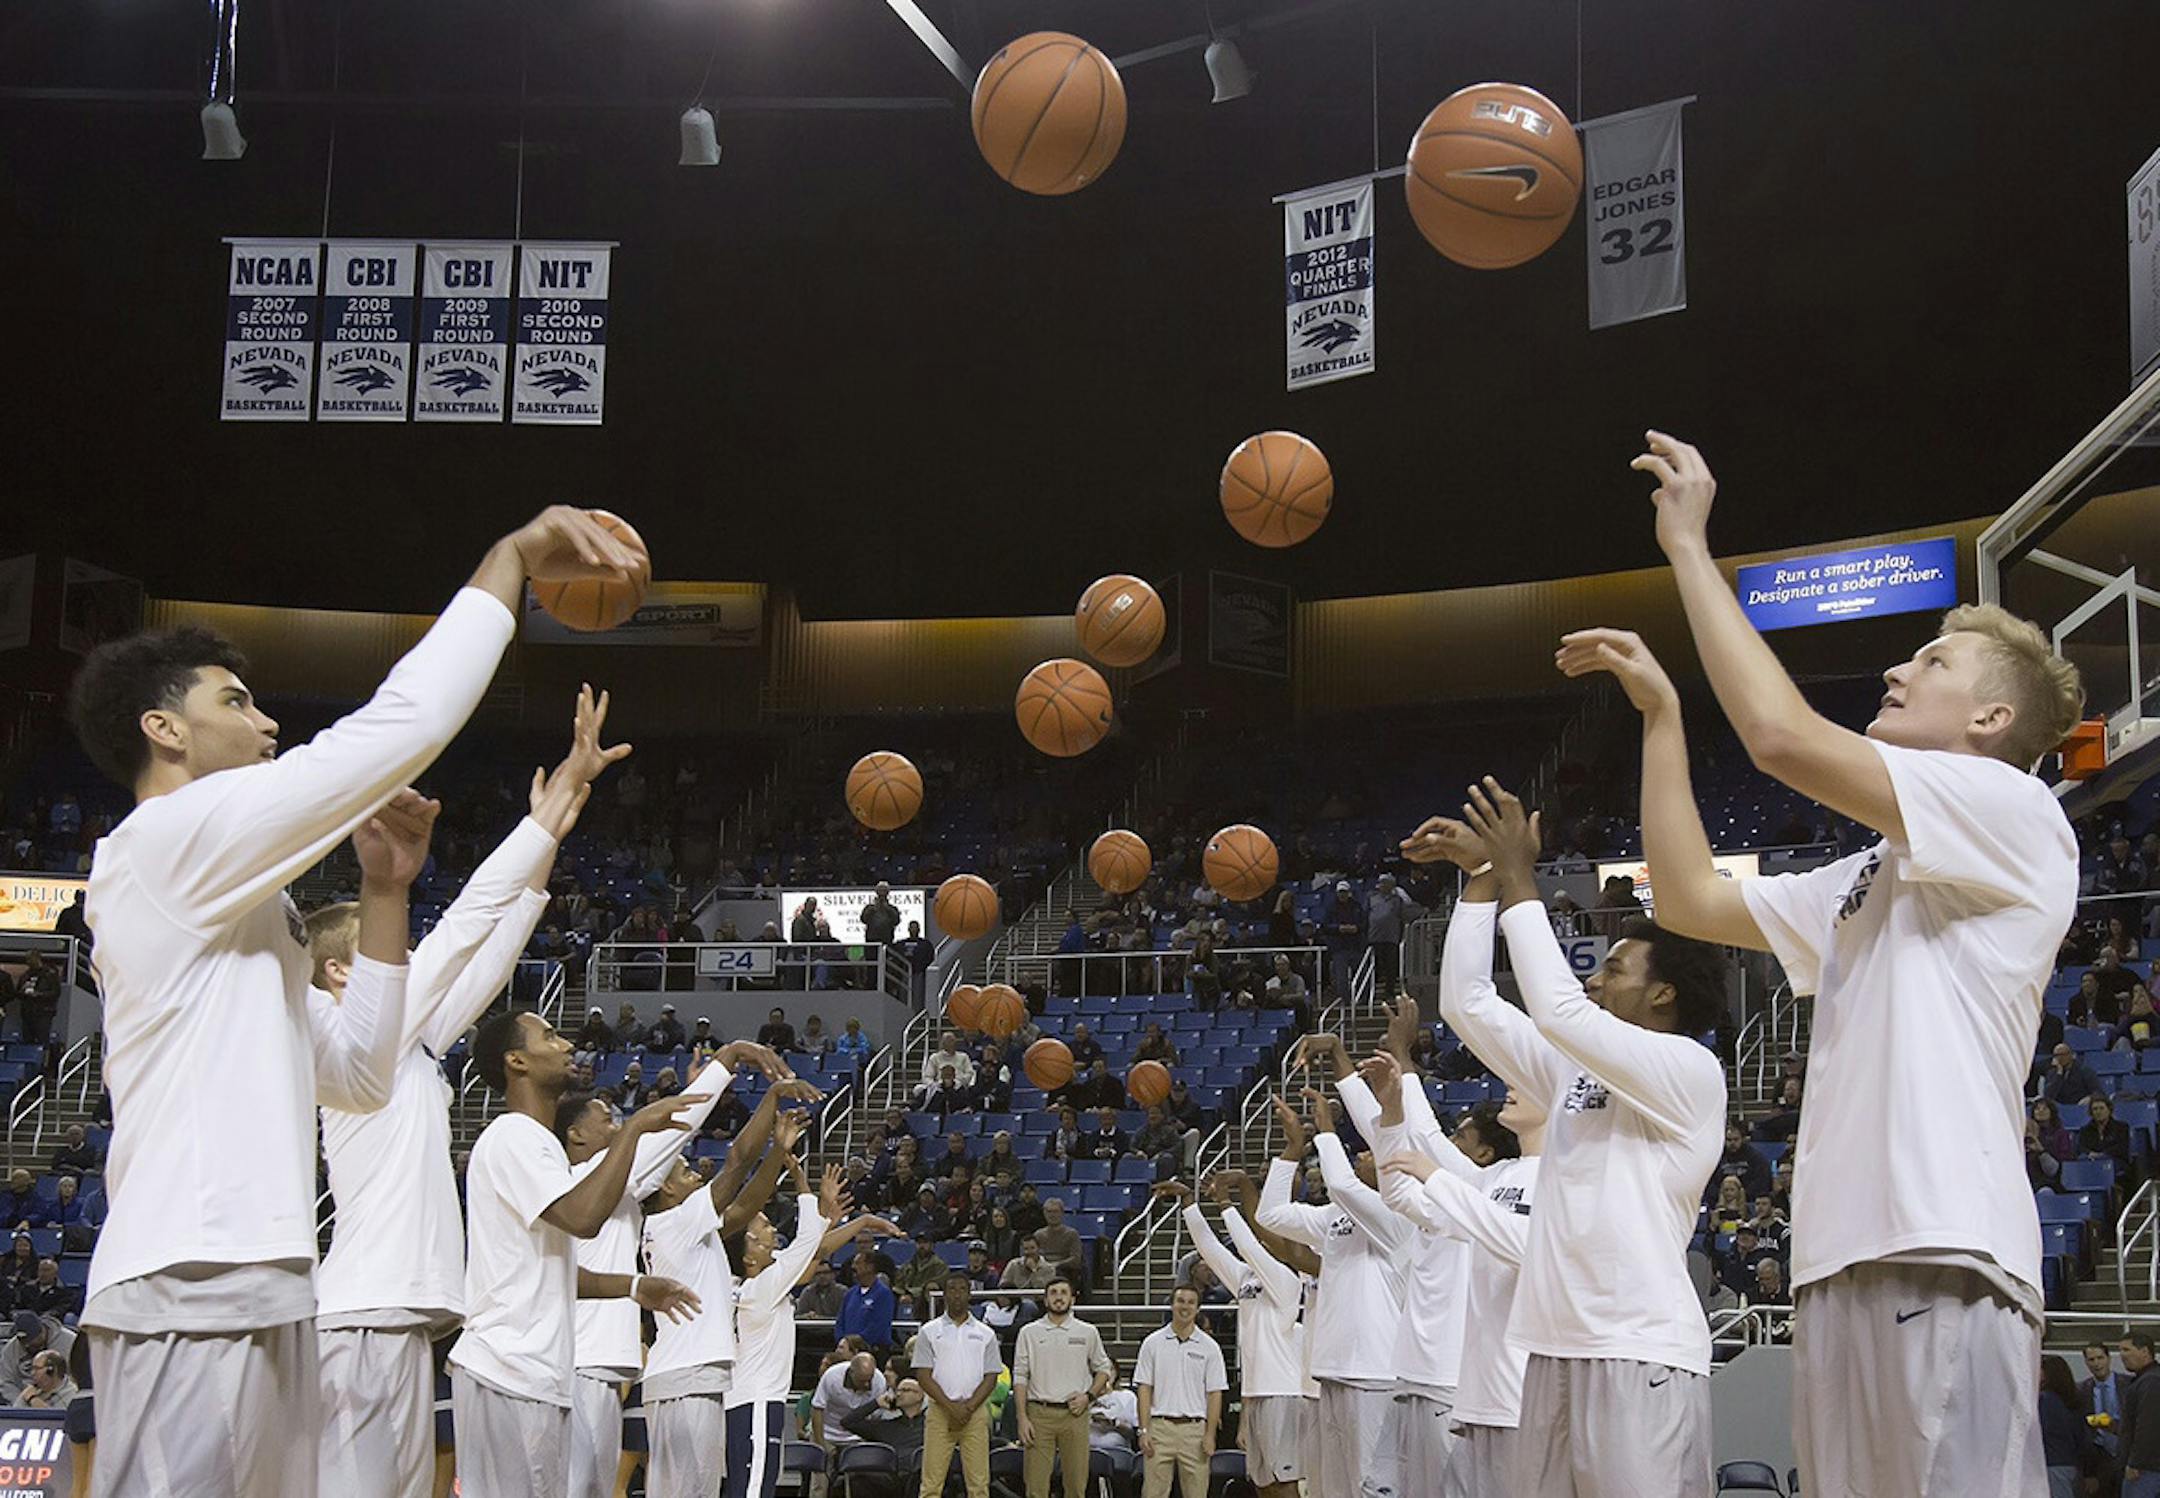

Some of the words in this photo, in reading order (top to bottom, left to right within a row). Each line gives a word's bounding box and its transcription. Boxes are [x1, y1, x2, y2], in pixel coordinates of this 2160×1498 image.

[1473, 100, 1552, 137] ELITE
[1594, 167, 1676, 201] EDGAR
[1594, 191, 1676, 222] JONES
[1304, 200, 1356, 240] NIT
[1600, 218, 1674, 265] 32
[1307, 245, 1348, 266] 2012
[236, 258, 313, 286] NCAA
[347, 258, 397, 287] CBI
[444, 260, 494, 287] CBI
[538, 260, 593, 288] NIT
[1290, 257, 1370, 286] QUARTER
[1303, 275, 1357, 298] FINALS
[252, 298, 296, 311] 2007
[347, 298, 391, 311] 2008
[445, 299, 488, 312] 2009
[541, 300, 581, 313] 2010
[237, 312, 309, 325] SECOND
[342, 313, 392, 326] FIRST
[440, 314, 490, 327] FIRST
[522, 315, 603, 328] SECOND
[1292, 299, 1369, 334] NEVADA
[240, 327, 303, 341] ROUND
[336, 328, 398, 341] ROUND
[433, 329, 495, 343] ROUND
[530, 330, 593, 343] ROUND
[230, 347, 306, 371] NEVADA
[327, 347, 403, 372] NEVADA
[423, 348, 499, 373] NEVADA
[521, 348, 598, 374] NEVADA
[1290, 352, 1371, 379] BASKETBALL
[226, 400, 305, 411] BASKETBALL
[322, 401, 402, 412] BASKETBALL
[419, 402, 499, 414] BASKETBALL
[517, 402, 598, 414] BASKETBALL
[1774, 569, 1806, 585] Run
[1810, 567, 1820, 578] a
[1823, 558, 1870, 577] smart
[1873, 553, 1914, 574] play.
[1748, 584, 1824, 605] Designate
[1827, 583, 1838, 594] a
[1843, 572, 1885, 591] sober
[1888, 566, 1944, 587] driver.
[718, 951, 754, 970] 24
[1559, 941, 1596, 970] 6
[0, 1429, 65, 1460] GNI
[0, 1467, 52, 1485] OUP
